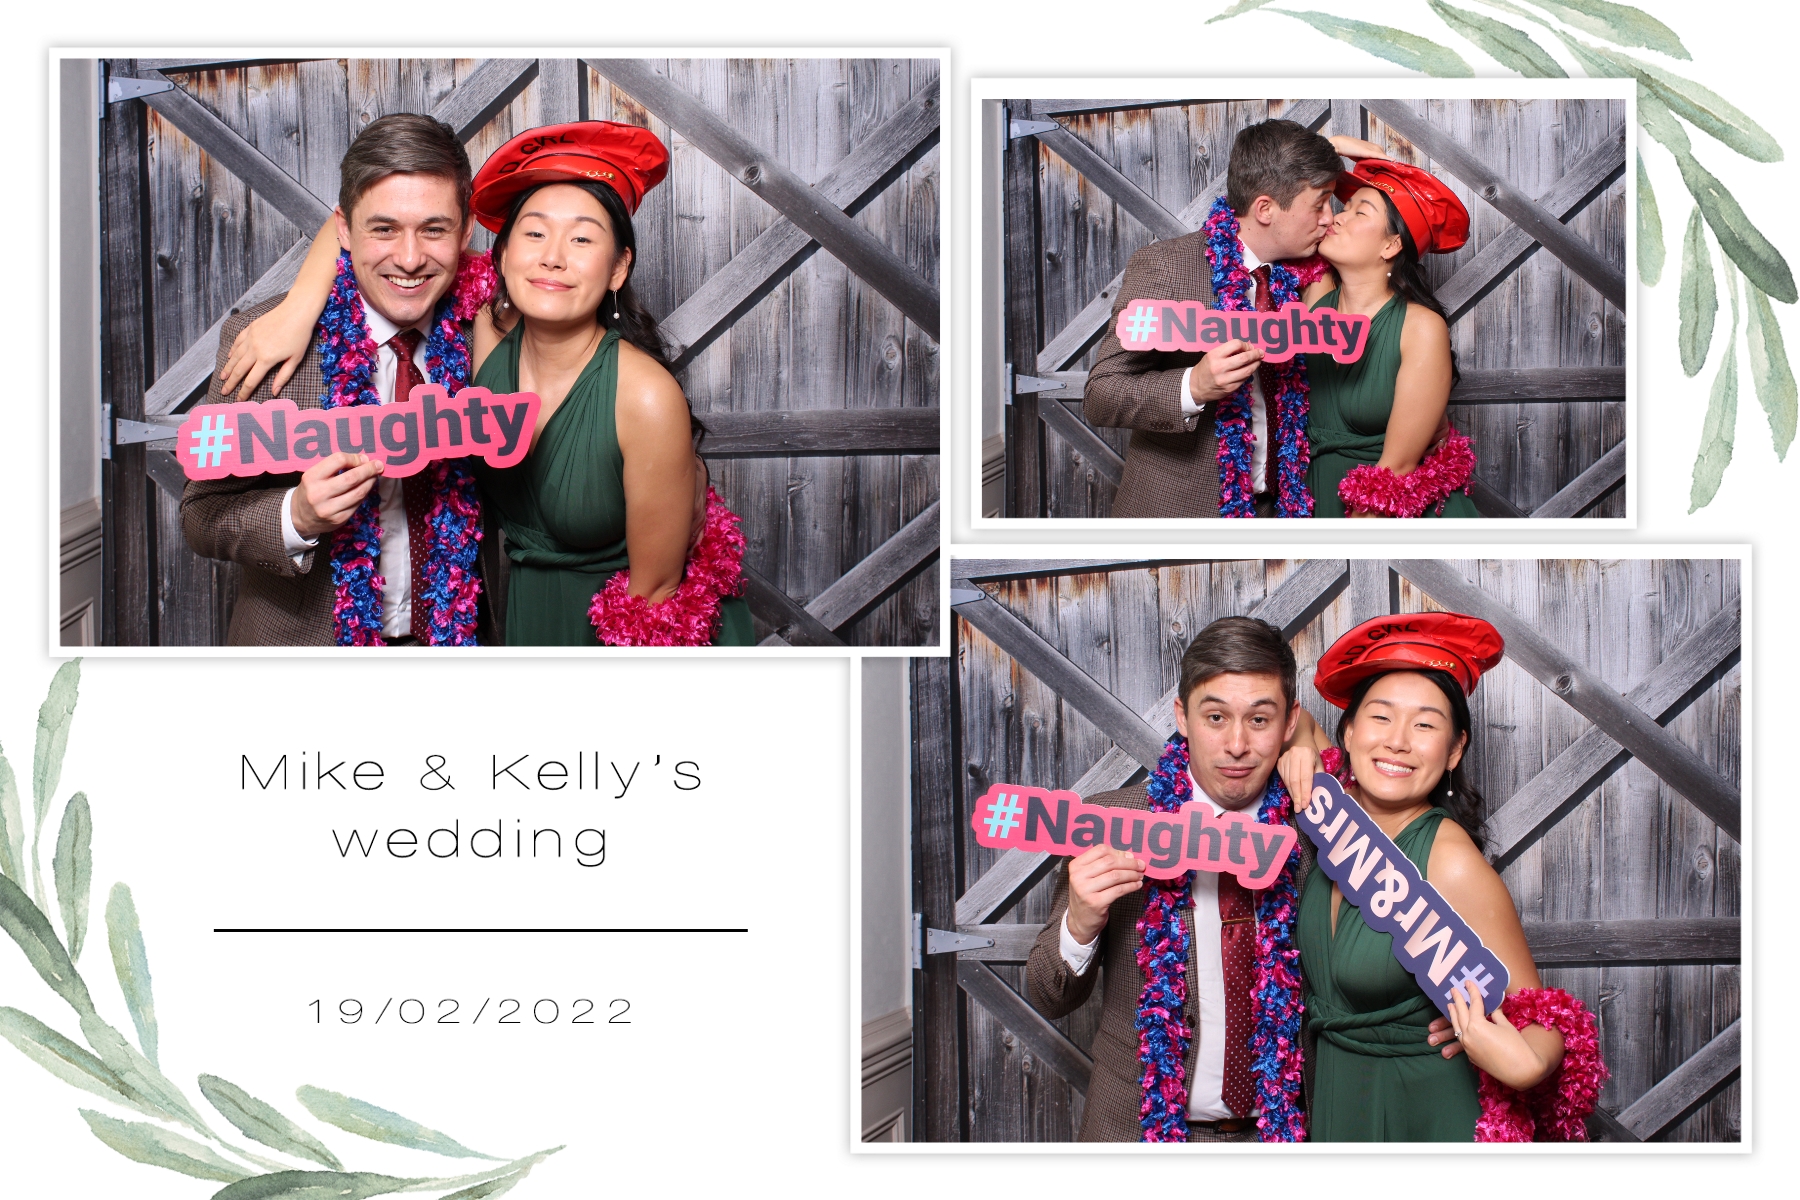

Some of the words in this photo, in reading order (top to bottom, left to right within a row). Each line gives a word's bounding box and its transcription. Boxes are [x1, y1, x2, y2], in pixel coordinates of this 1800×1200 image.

[1125, 306, 1363, 355] #Naughty
[189, 394, 530, 466] #Naughty
[1337, 645, 1367, 666] AD
[983, 792, 1286, 880] #Naughty
[1304, 785, 1495, 1003] #Mr&Mrs
